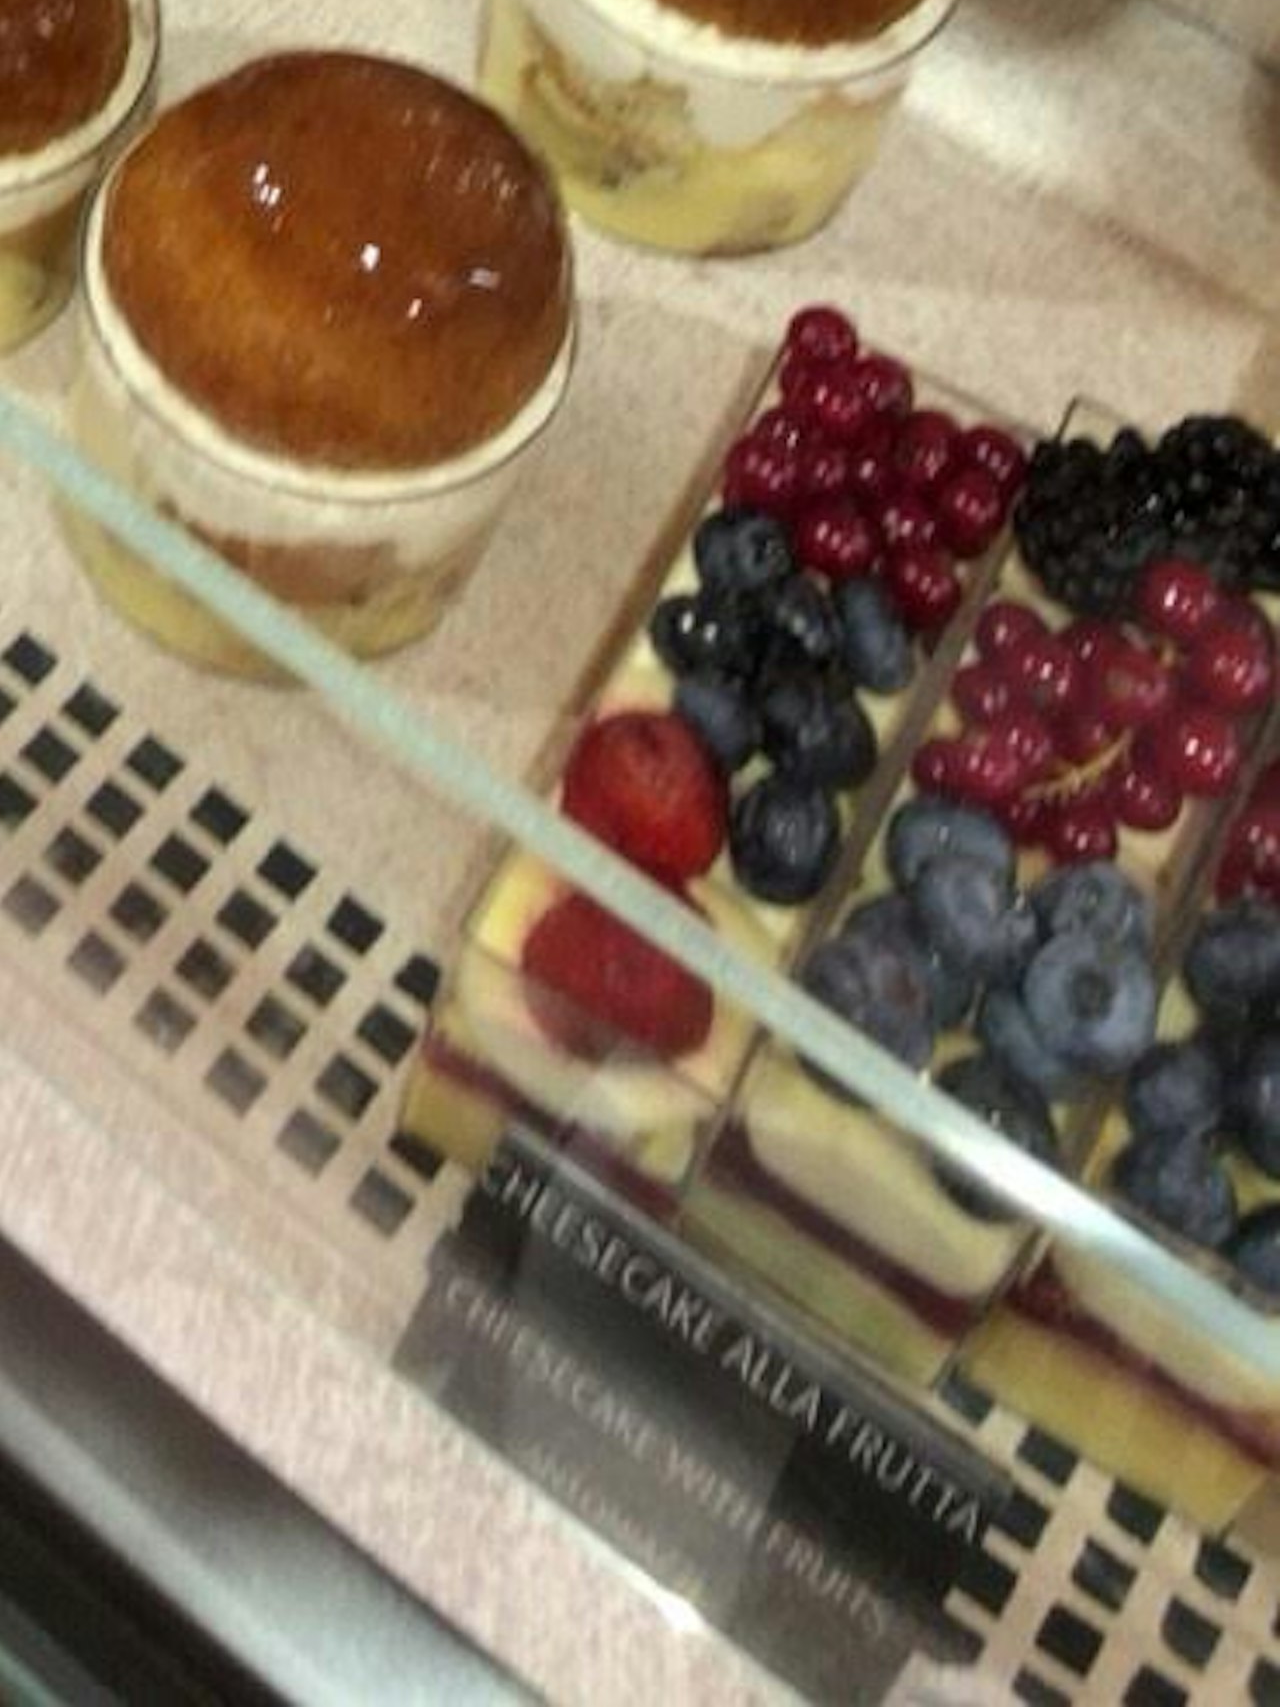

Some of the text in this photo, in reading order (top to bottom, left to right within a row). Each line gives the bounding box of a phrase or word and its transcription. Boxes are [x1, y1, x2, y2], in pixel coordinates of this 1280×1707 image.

[446, 1275, 893, 1635] CHEESECAKE WITH FRUITS
[482, 1160, 984, 1545] CHEESECAKE ALLA FRUTTA
